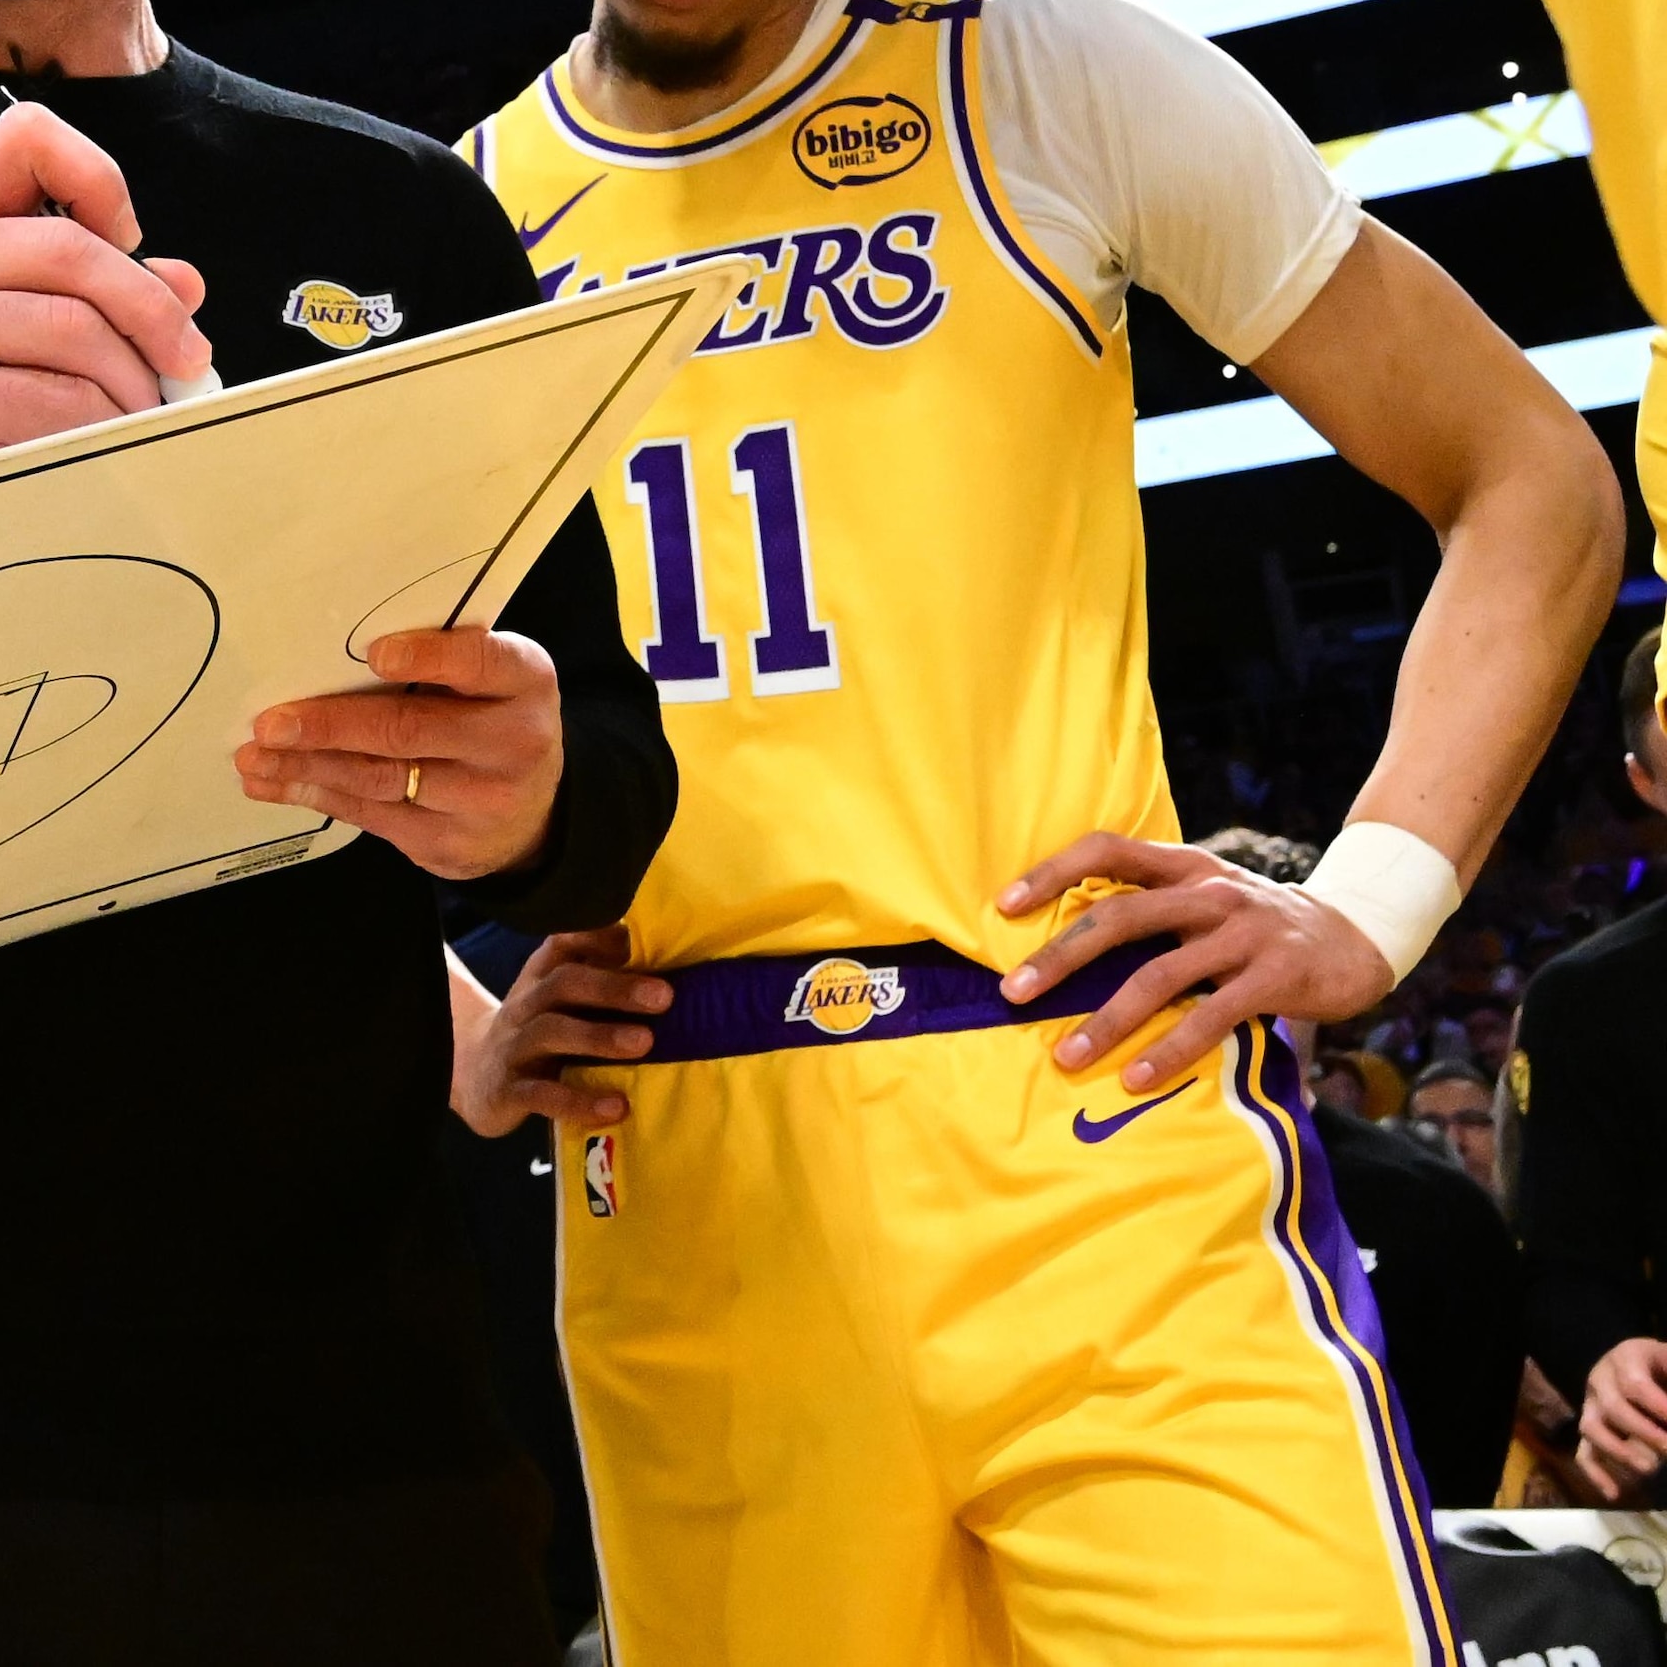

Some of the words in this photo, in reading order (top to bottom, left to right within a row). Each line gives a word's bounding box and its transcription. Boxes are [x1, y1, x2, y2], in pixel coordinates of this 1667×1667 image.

[805, 119, 921, 156] bibigo
[289, 294, 398, 332] LAKERS
[623, 420, 840, 705] 11
[793, 980, 899, 1016] LAKERS
